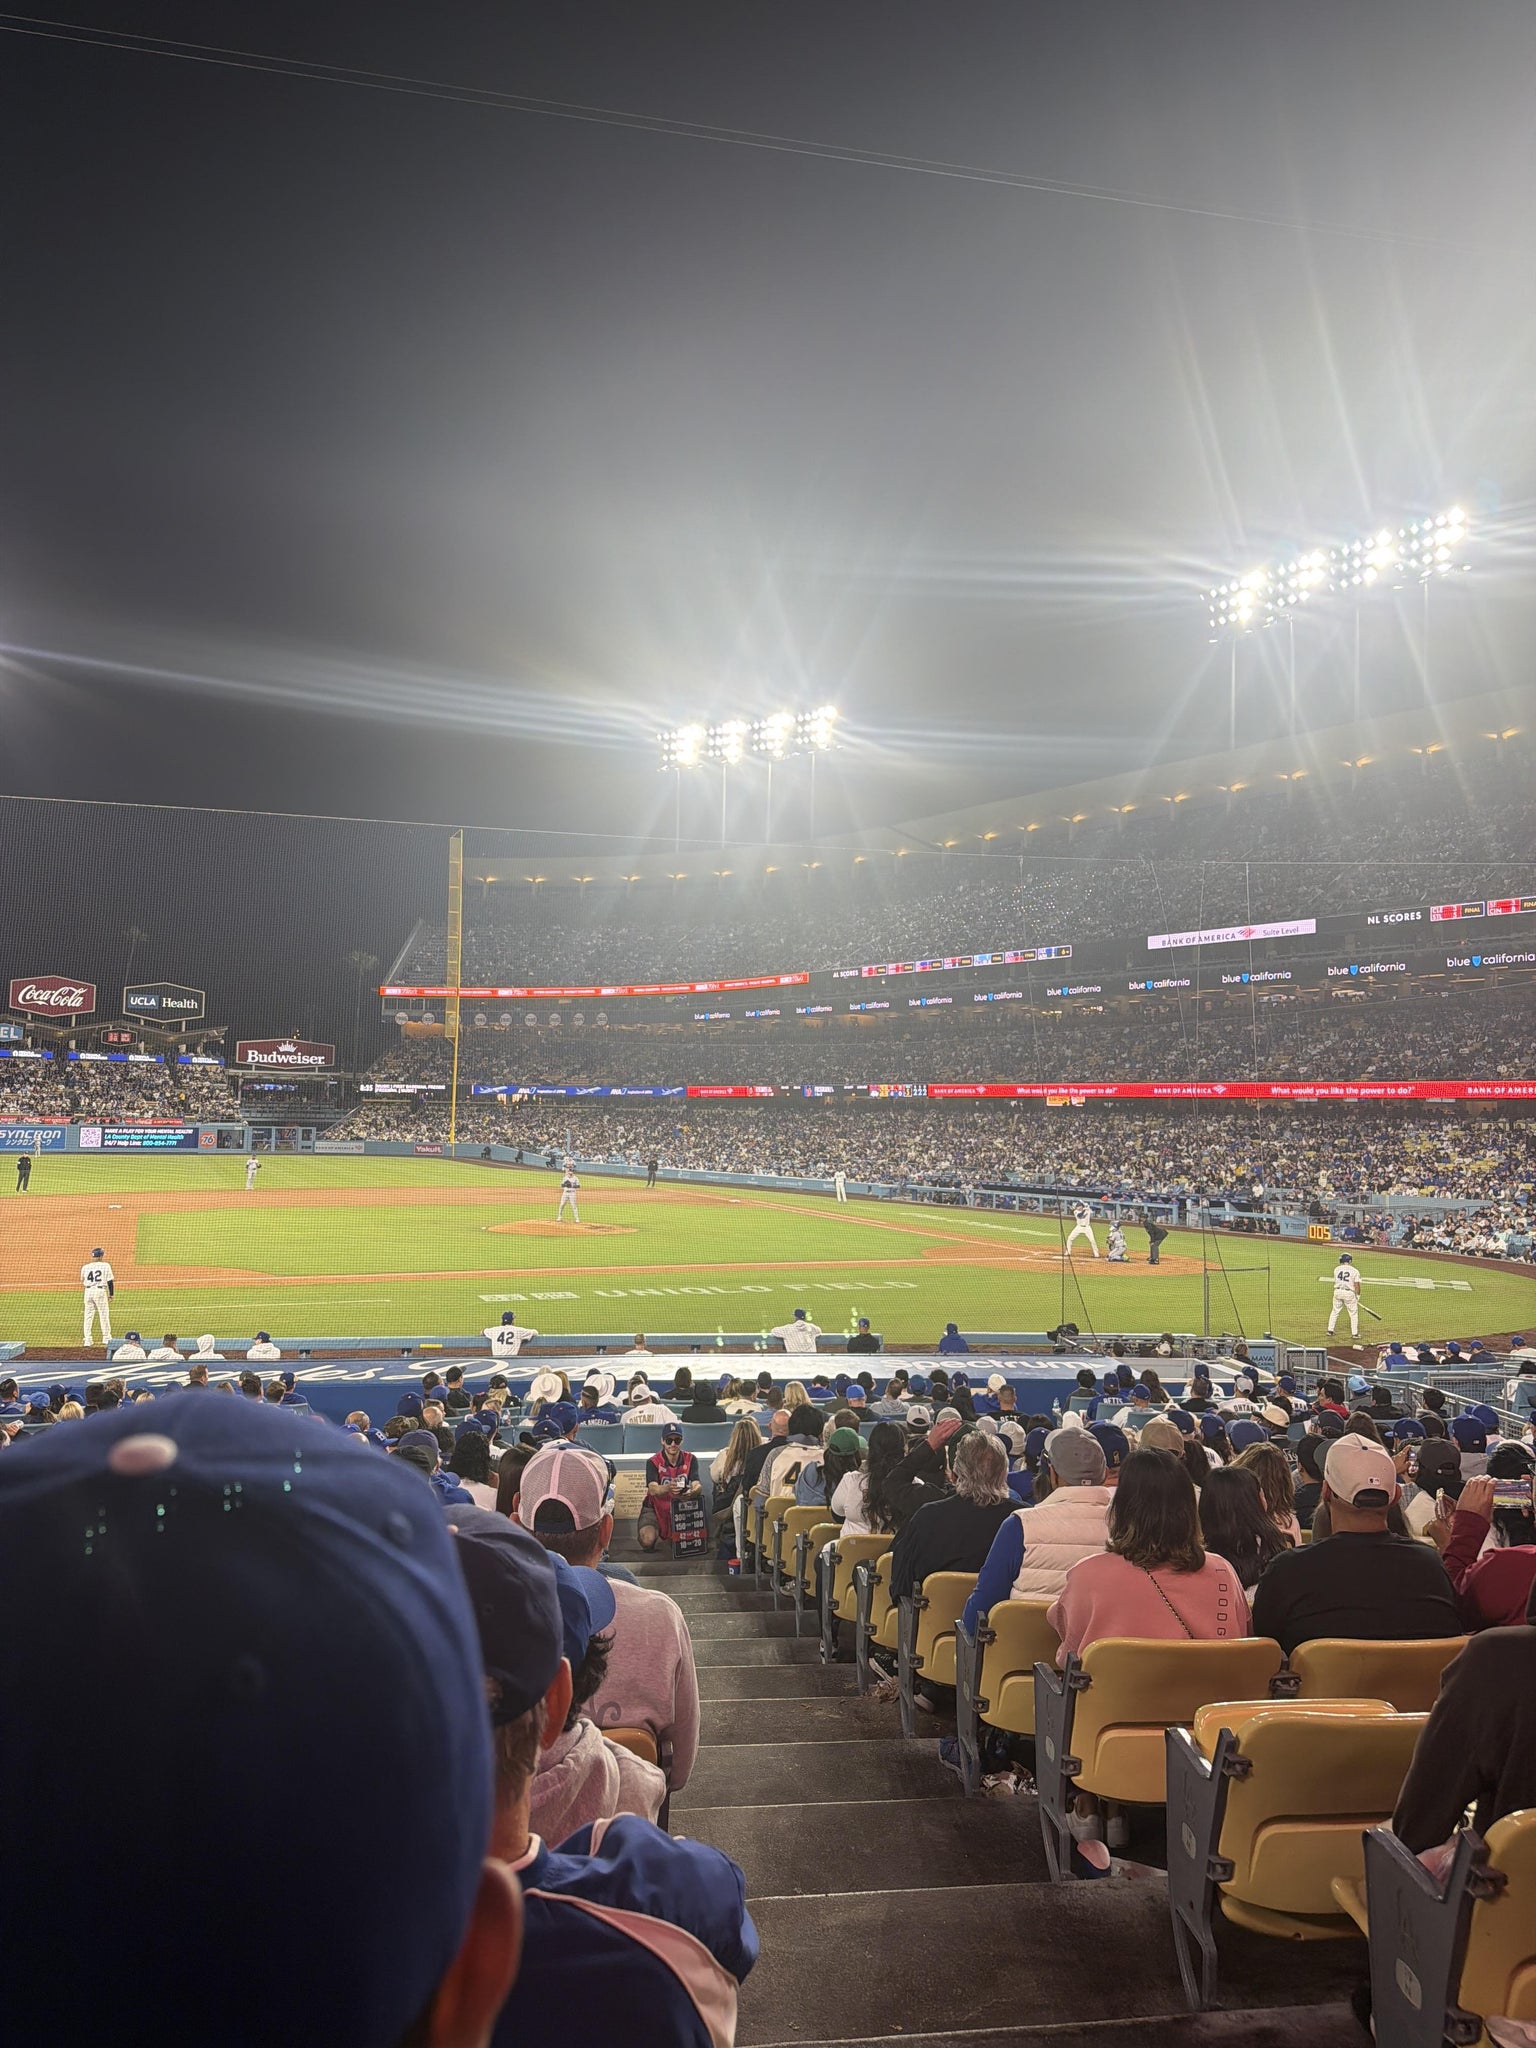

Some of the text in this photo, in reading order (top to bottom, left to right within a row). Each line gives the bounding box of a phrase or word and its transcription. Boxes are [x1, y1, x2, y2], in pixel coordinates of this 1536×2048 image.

[1367, 912, 1422, 925] NL SCORES
[1262, 926, 1299, 936] Suite Level
[1162, 939, 1184, 947] BANK
[1198, 933, 1236, 943] AMERICA
[1447, 952, 1536, 968] blue california
[840, 969, 858, 978] SCORES
[1328, 962, 1406, 976] blue california
[1222, 970, 1292, 984] blue california
[1129, 978, 1190, 990] blue california
[18, 984, 88, 1008] Coca-Cola
[994, 991, 1022, 1000] california
[1047, 985, 1101, 996] blue california
[130, 996, 198, 1009] UCLA Health
[850, 1001, 889, 1011] blue california
[926, 997, 952, 1005] california
[247, 1050, 323, 1065] Budweiser
[1271, 1086, 1290, 1094] What
[1291, 1086, 1314, 1094] would
[1315, 1088, 1329, 1096] you
[1329, 1086, 1344, 1094] like
[1345, 1086, 1358, 1094] the
[1359, 1088, 1385, 1096] power
[202, 1135, 214, 1144] 76
[1309, 1225, 1331, 1240] 005
[87, 1269, 102, 1282] 42
[1337, 1271, 1350, 1281] 42
[784, 1281, 918, 1291] FIELD
[497, 1331, 515, 1345] 42
[880, 1358, 1093, 1371] Spectrum
[680, 1541, 687, 1549] 10
